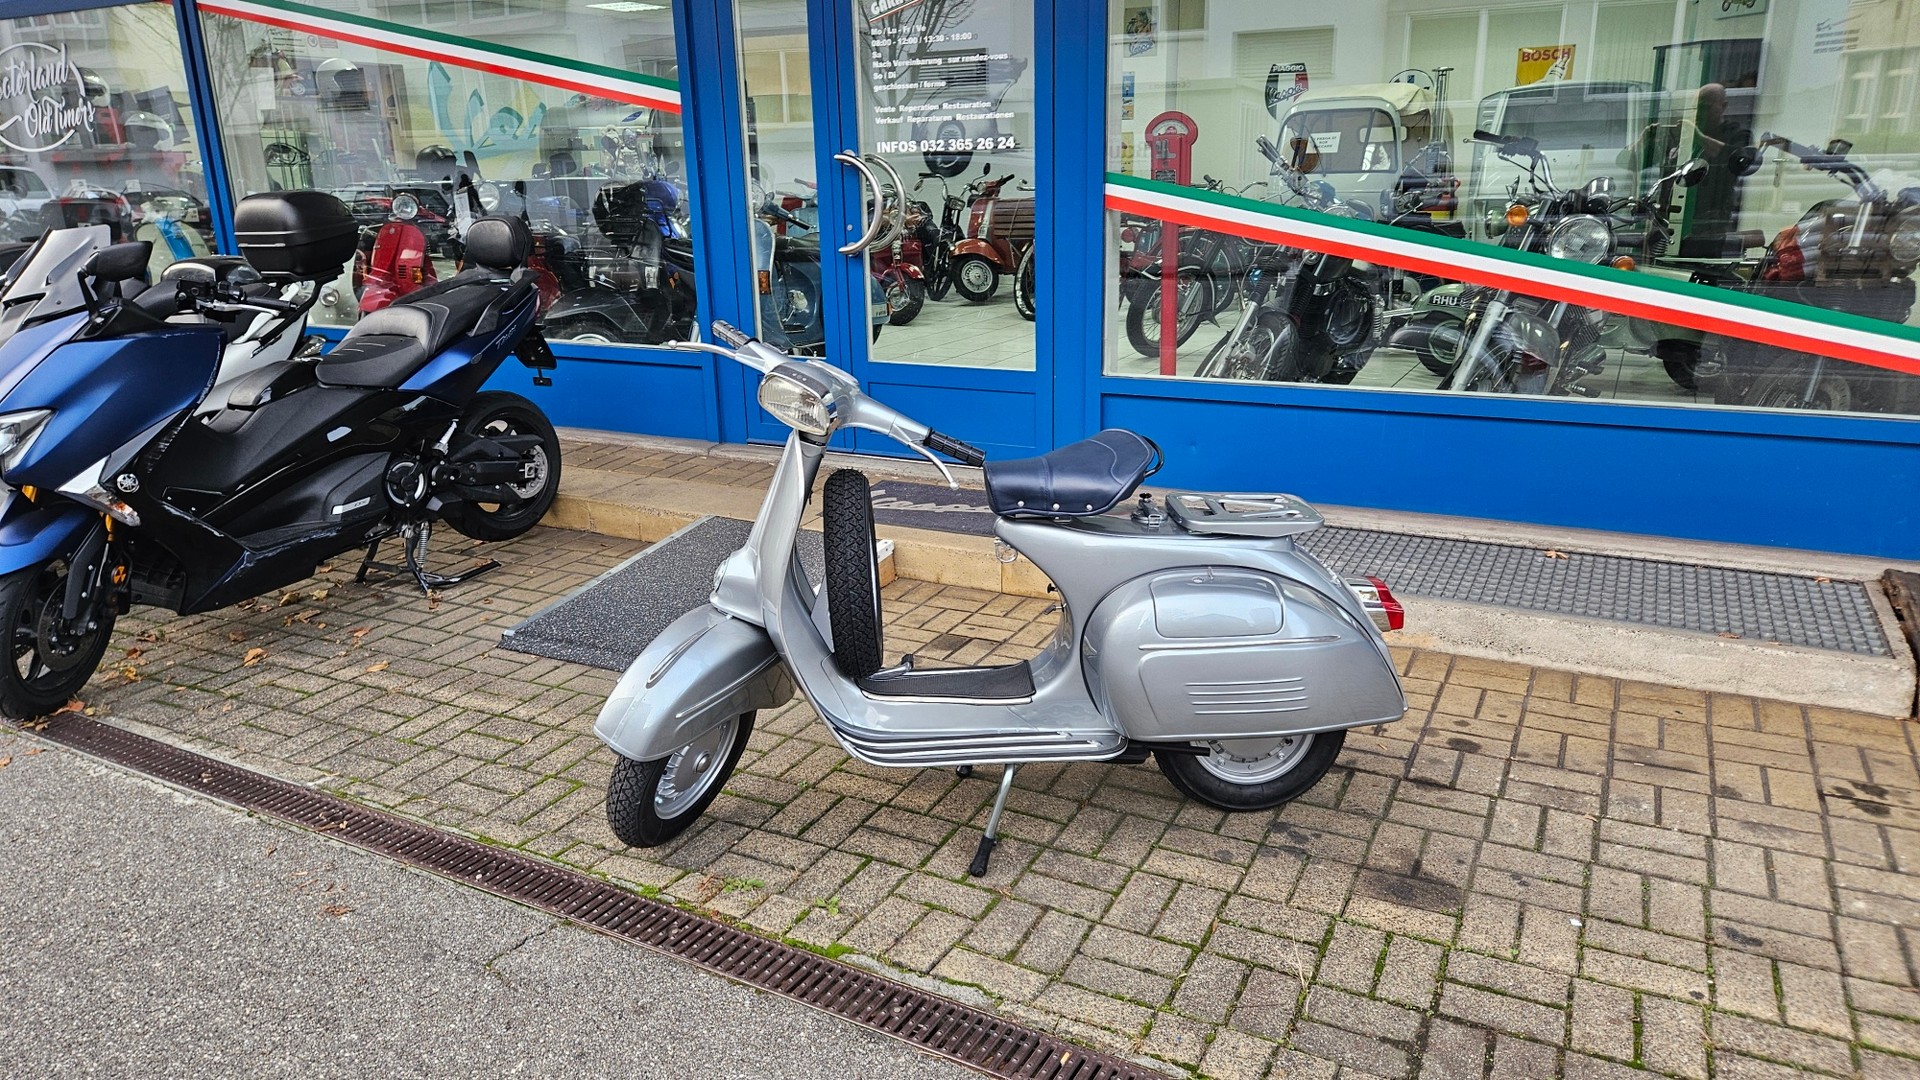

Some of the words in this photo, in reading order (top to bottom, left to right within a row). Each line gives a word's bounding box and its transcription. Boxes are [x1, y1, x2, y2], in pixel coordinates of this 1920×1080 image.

[872, 38, 892, 46] 08:00
[924, 34, 944, 43] 13:30
[951, 32, 972, 40] 18:00
[872, 51, 882, 59] Sa
[892, 58, 942, 66] Vereinbarung
[962, 54, 1008, 62] rendez-vous
[1522, 48, 1572, 62] BOSCH
[0, 43, 69, 104] oterland
[874, 82, 918, 92] geschlossen
[1267, 83, 1307, 107] Vespa
[942, 101, 992, 110] Restauration
[875, 116, 903, 124] Verkauf
[906, 115, 952, 124] Reparaturen
[956, 112, 1014, 120] Restaurationen
[876, 140, 917, 154] INFOS
[920, 140, 945, 152] 032
[948, 138, 974, 151] 365
[976, 138, 994, 150] 26
[998, 136, 1016, 150] 24
[1432, 295, 1458, 306] RHU
